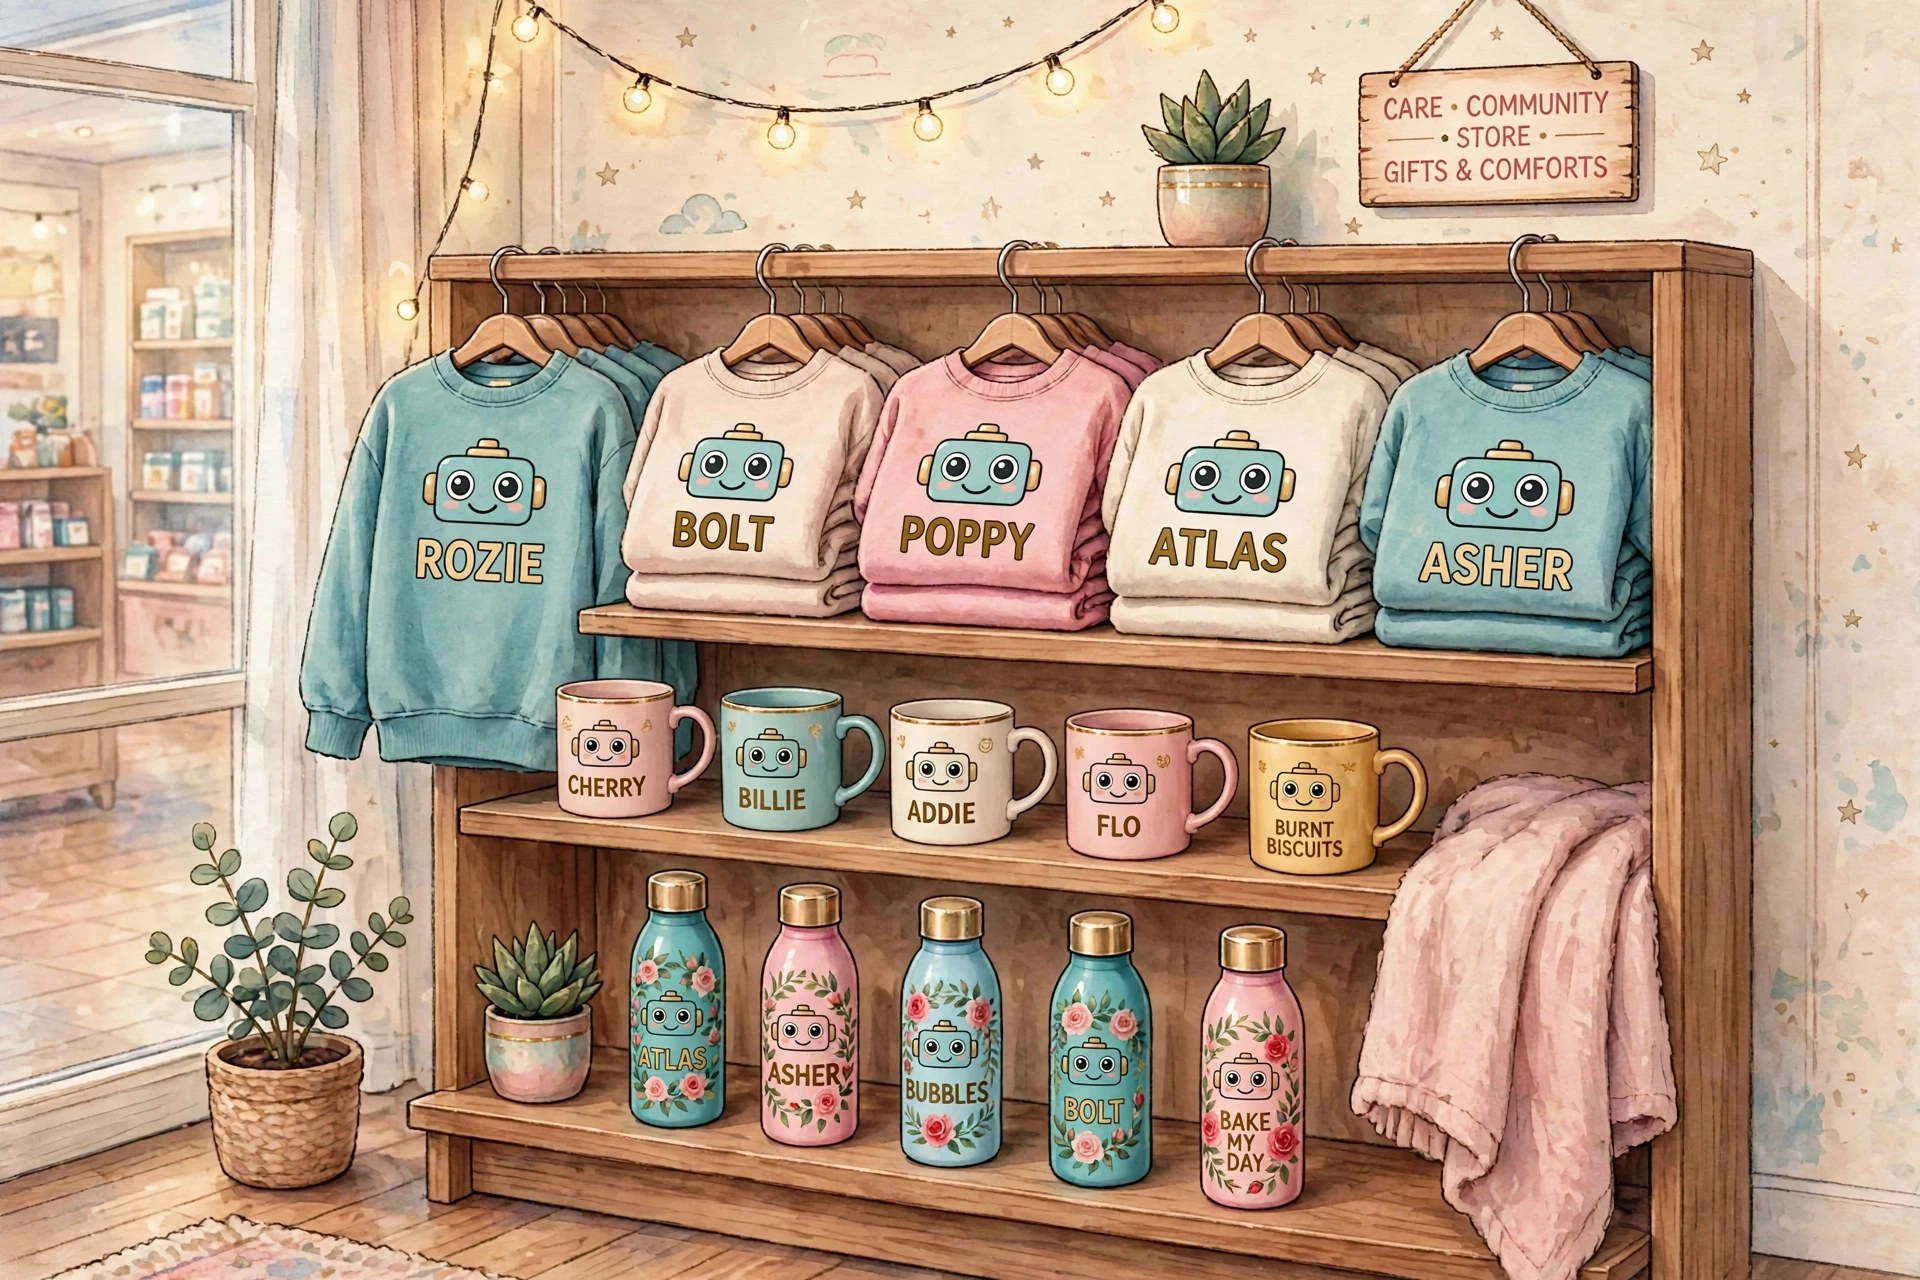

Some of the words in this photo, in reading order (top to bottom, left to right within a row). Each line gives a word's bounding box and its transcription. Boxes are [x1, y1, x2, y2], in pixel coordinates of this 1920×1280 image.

[1383, 96, 1443, 121] CARE
[1466, 90, 1609, 117] COMMUNITY
[1456, 125, 1531, 149] STORE
[1384, 159, 1448, 183] GIFTS
[1456, 158, 1472, 181] &
[1479, 155, 1608, 181] COMFORTS
[672, 510, 776, 554] BOLT
[899, 514, 1036, 562] POPPY
[415, 538, 546, 585] ROZIE
[1148, 526, 1289, 574] ATLAS
[1419, 540, 1573, 592] ASHER
[567, 773, 646, 799] CHERRY
[738, 786, 807, 812] BILLIE
[907, 798, 976, 825] ADDIE
[1097, 814, 1142, 838] FLO
[1275, 819, 1334, 838] BURNT
[1266, 838, 1343, 858] BISCUITS
[637, 1045, 708, 1072] ATLAS
[768, 1061, 841, 1087] ASHER
[905, 1077, 989, 1106] BUBBLES
[1064, 1096, 1125, 1125] BOLT
[1220, 1110, 1271, 1131] BAKE
[1227, 1132, 1256, 1152] MY
[1227, 1153, 1265, 1172] DAY
